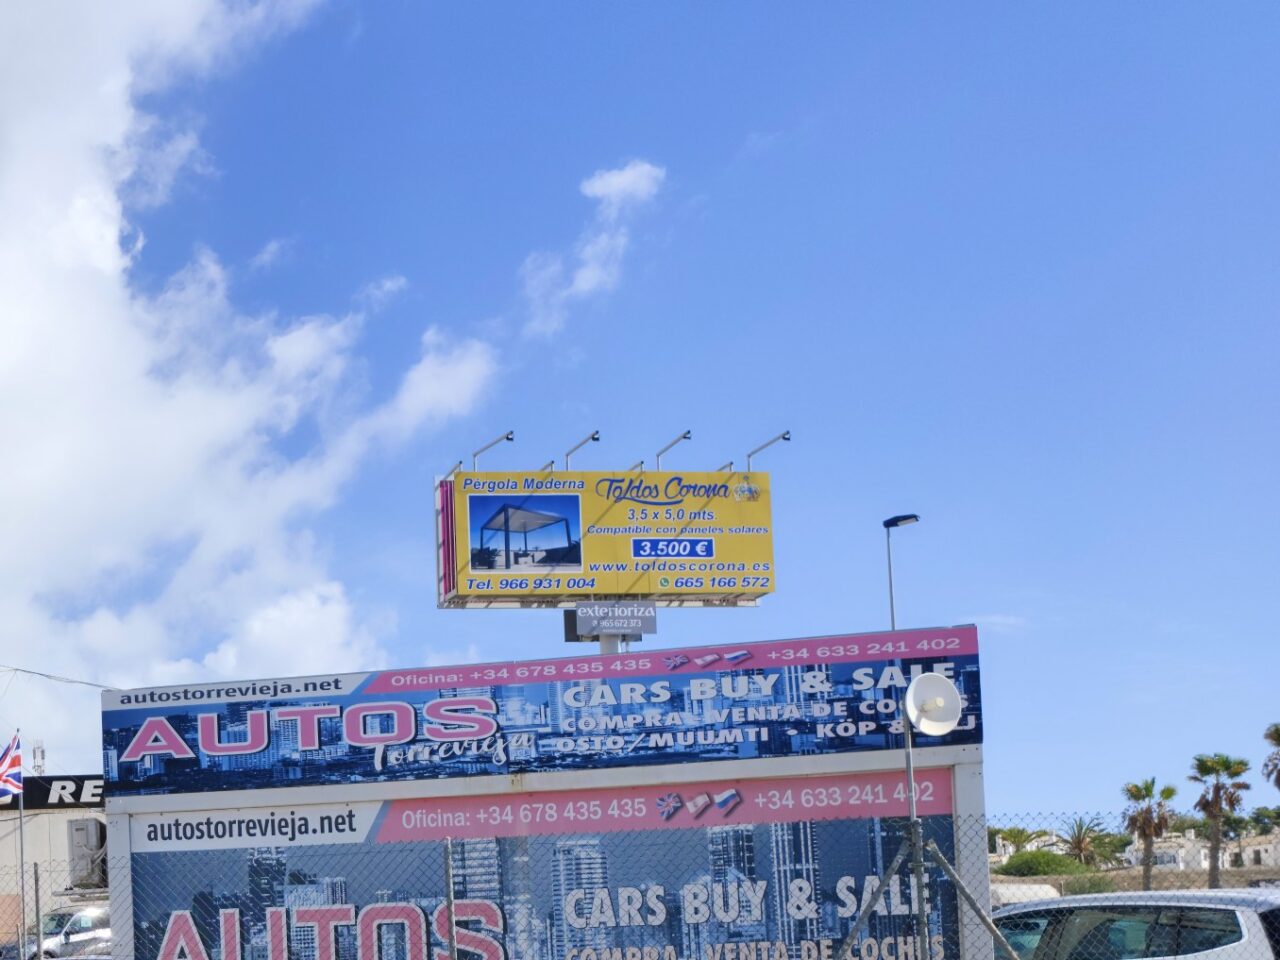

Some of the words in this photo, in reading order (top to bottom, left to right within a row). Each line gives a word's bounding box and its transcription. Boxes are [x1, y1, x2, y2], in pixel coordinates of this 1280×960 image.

[523, 478, 585, 490] Moderna
[595, 477, 659, 505] Toldos
[664, 476, 731, 500] Corona
[627, 508, 648, 521] 3,5
[652, 512, 660, 520] x
[664, 508, 685, 521] 5,0
[689, 509, 718, 521] mts.
[587, 525, 652, 535] Compatible
[655, 526, 677, 534] con
[680, 525, 724, 536] paneles
[728, 525, 769, 534] solares
[639, 541, 690, 556] 3.500
[695, 541, 708, 555] €
[589, 561, 770, 573] www.toldoscorona.es
[466, 578, 494, 590] Tel.
[499, 578, 529, 590] 966
[533, 578, 561, 589] 931
[566, 577, 596, 589] 004
[674, 577, 704, 588] 665
[709, 577, 737, 588] 166
[741, 577, 770, 588] 572
[577, 603, 656, 617] exterioriza
[767, 646, 808, 661] +34
[816, 644, 860, 658] 633
[867, 641, 909, 655] 241
[916, 637, 961, 651] 402
[391, 673, 464, 687] Oficina:
[470, 667, 510, 680] +34
[515, 664, 557, 678] 678
[562, 660, 604, 675] 435
[610, 656, 652, 672] 435
[119, 676, 343, 706] autostorrevieja.net
[563, 680, 672, 709] CARS
[689, 673, 780, 701] BUY
[800, 670, 833, 694] &
[119, 696, 499, 763] AUTOS
[562, 711, 683, 733] COMPRA
[710, 703, 801, 724] VENTA
[812, 701, 848, 717] DE
[816, 718, 877, 738] KÖP
[360, 732, 535, 772] Torrevieja
[754, 787, 793, 810] +34
[800, 785, 842, 808] 633
[849, 783, 888, 805] 241
[893, 781, 934, 802] 402
[146, 808, 356, 842] autostorrevieja.net
[401, 808, 471, 829] Oficina:
[476, 804, 514, 825] +34
[519, 802, 558, 823] 678
[562, 800, 602, 821] 435
[607, 798, 647, 819] 435
[565, 884, 668, 929] CARS
[683, 880, 768, 925] BUY
[786, 877, 820, 920] &
[835, 872, 932, 918] SALE
